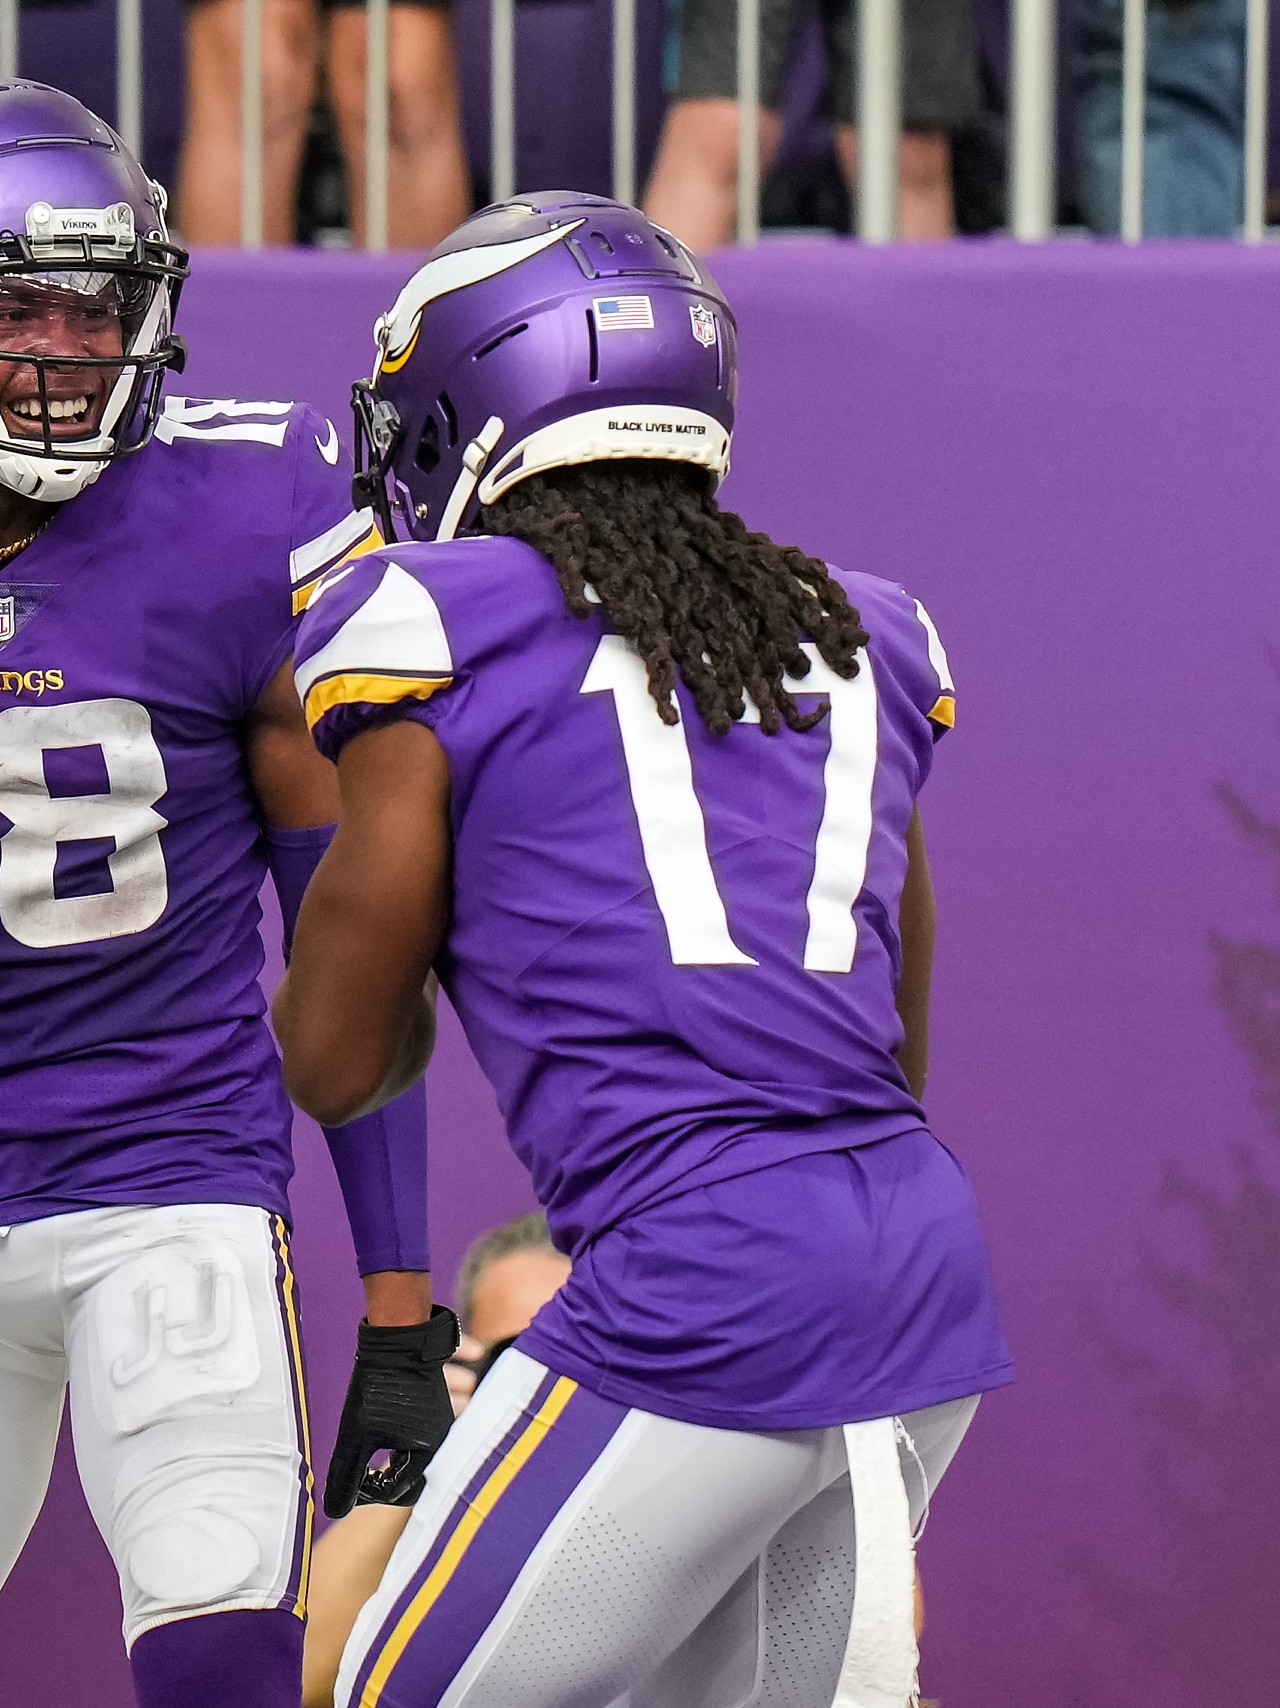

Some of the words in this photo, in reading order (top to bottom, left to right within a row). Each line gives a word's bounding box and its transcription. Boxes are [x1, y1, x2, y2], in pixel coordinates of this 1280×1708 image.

[608, 421, 642, 431] BLACK
[646, 423, 672, 433] LIVES
[676, 425, 706, 435] MATTER
[579, 634, 877, 974] 17
